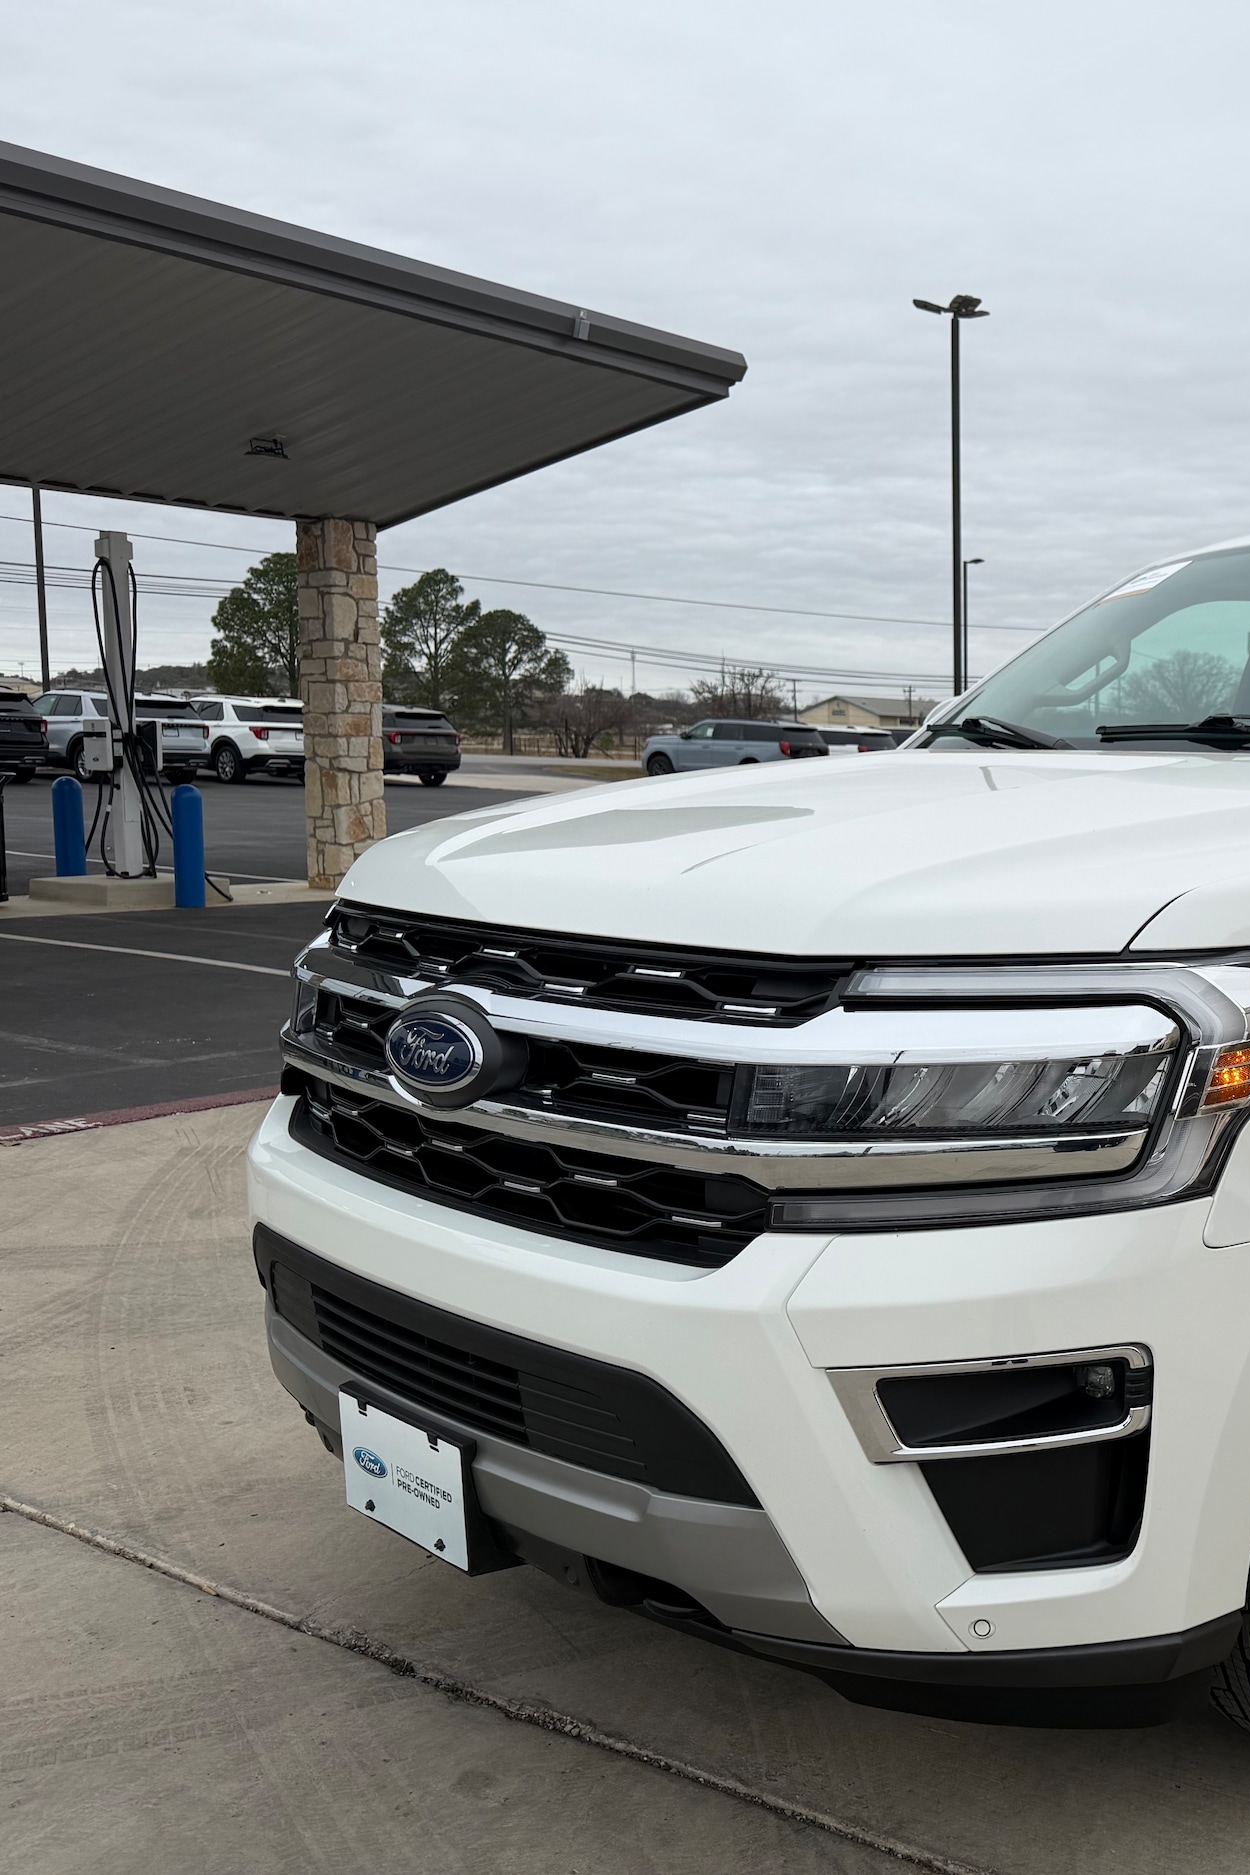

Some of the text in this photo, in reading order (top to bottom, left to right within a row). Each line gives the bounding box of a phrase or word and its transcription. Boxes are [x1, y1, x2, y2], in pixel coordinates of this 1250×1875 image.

[400, 1026, 455, 1075] Ford
[359, 1450, 381, 1475] Ford
[396, 1465, 453, 1503] FORD CERTIFIED
[397, 1478, 441, 1509] PRE-OWNED
